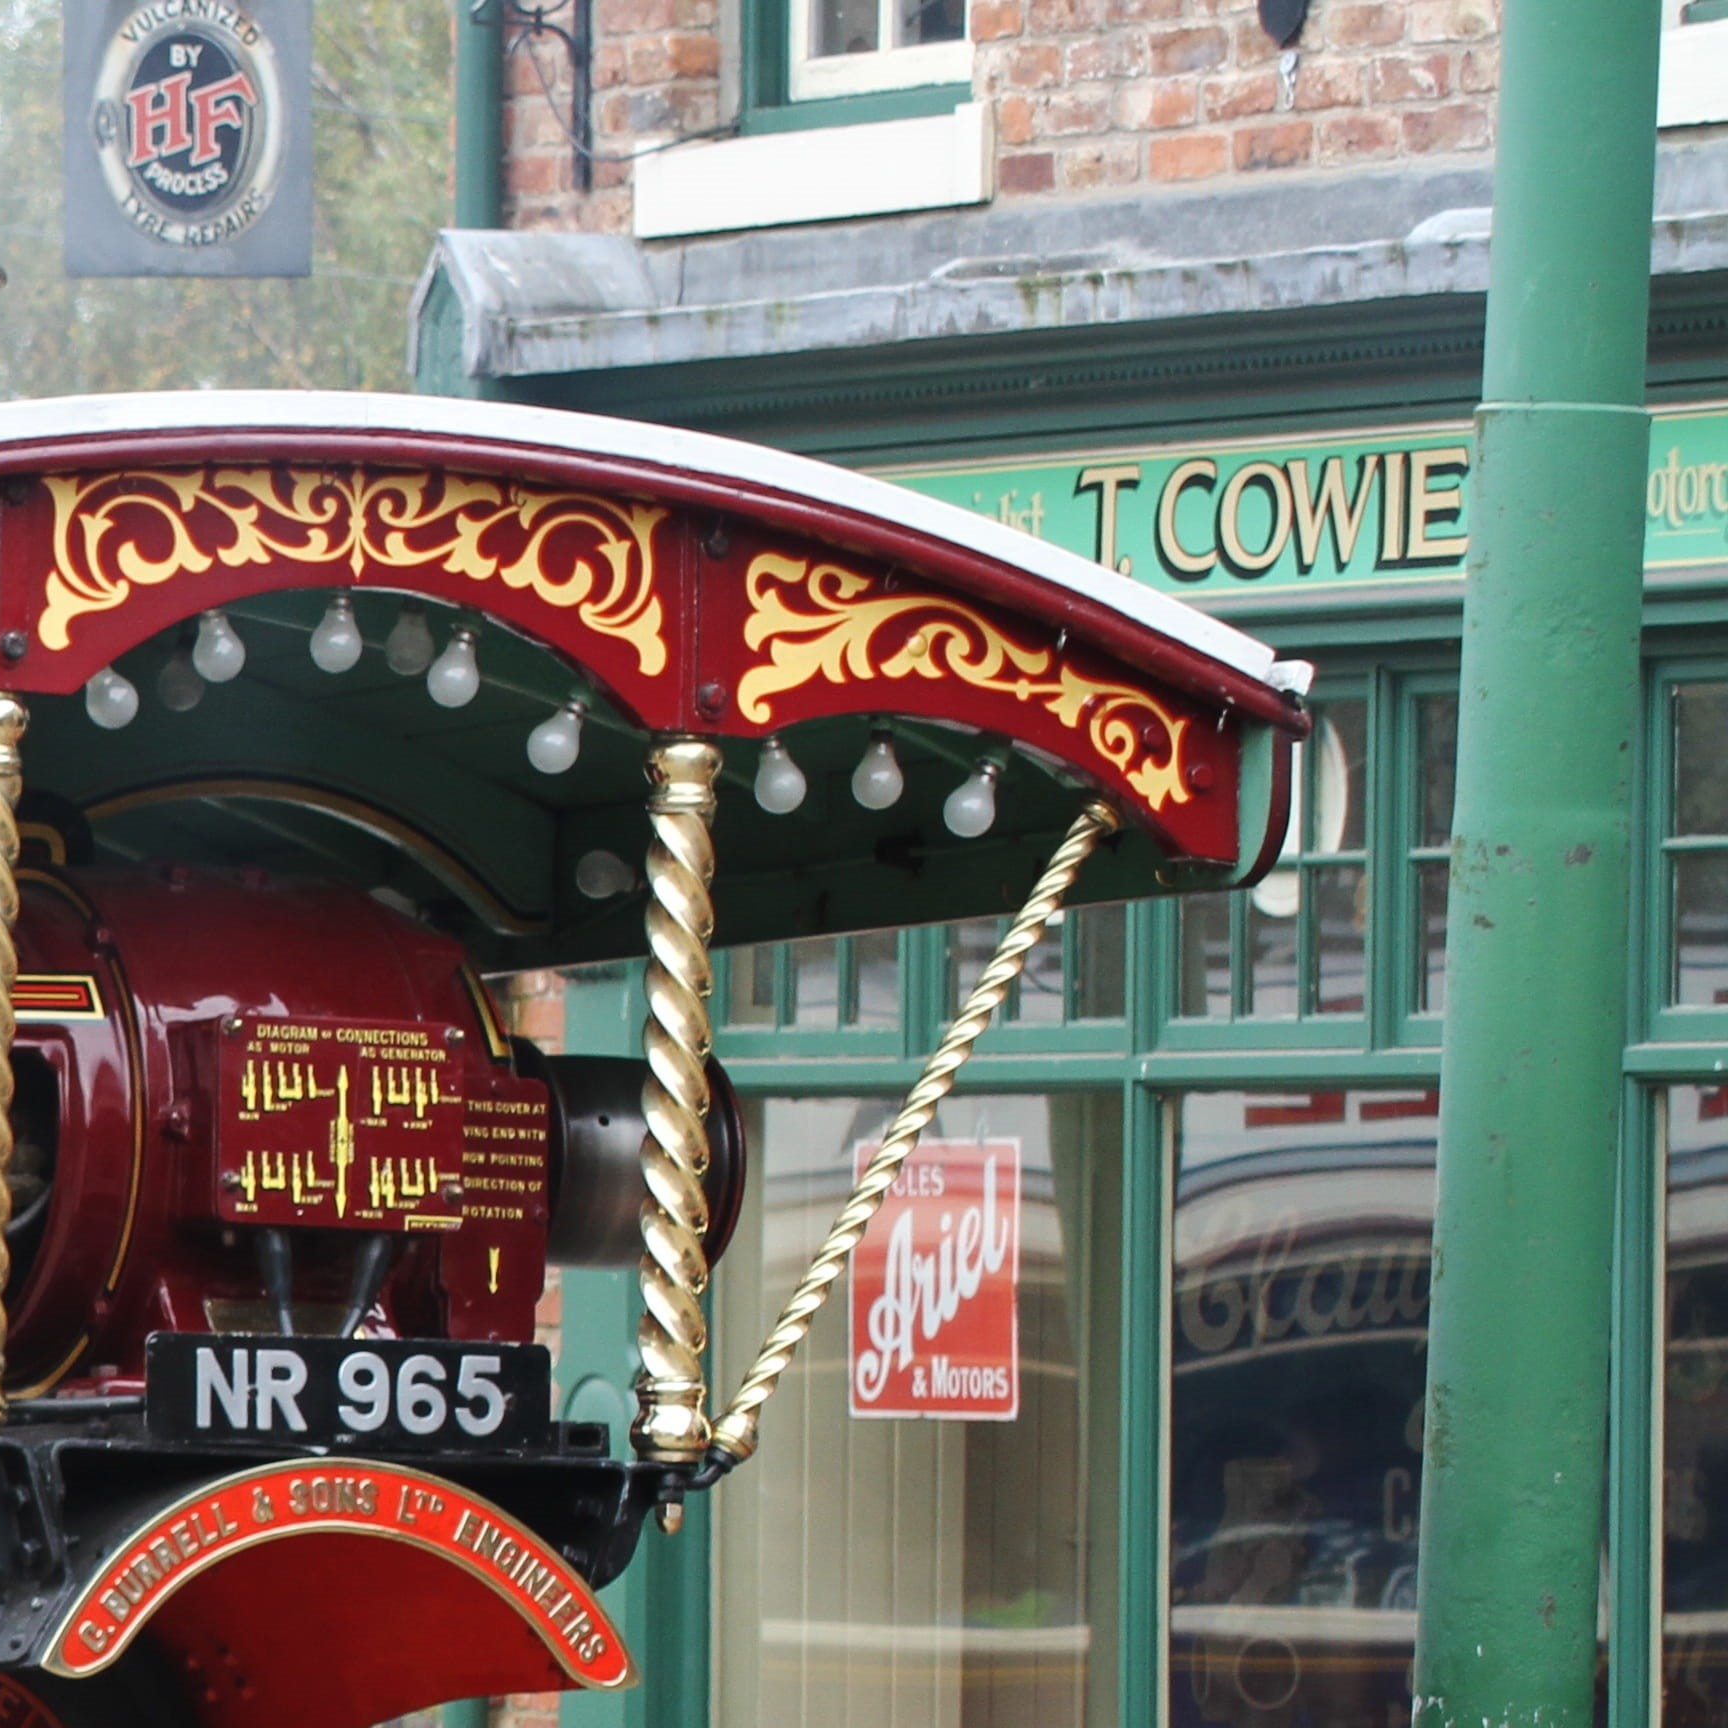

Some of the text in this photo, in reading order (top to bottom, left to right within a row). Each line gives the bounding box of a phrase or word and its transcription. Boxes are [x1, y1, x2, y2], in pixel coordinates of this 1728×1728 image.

[121, 0, 259, 47] VULCANIZED
[169, 43, 203, 67] BY
[125, 69, 258, 168] HF
[143, 160, 229, 196] PROCESS
[121, 186, 270, 248] TYRE REPAIRS
[1152, 445, 1471, 584] COWIE
[256, 1024, 318, 1041] DIAGRAM
[335, 1027, 429, 1047] CONNECTIONS
[269, 1042, 311, 1055] MOTOR
[380, 1048, 447, 1063] GENERATOR
[462, 1125, 489, 1139] VING
[490, 1151, 545, 1168] POINTING
[463, 1176, 525, 1193] DIRECTION
[885, 1162, 944, 1198] CLES
[461, 1204, 524, 1220] ROTATION
[856, 1154, 1009, 1402] Ariel
[195, 1347, 509, 1437] NR 965
[912, 1355, 1010, 1399] & MOTORS
[99, 1500, 239, 1623] BURRELL
[251, 1485, 275, 1524] &
[288, 1475, 380, 1516] SONS
[452, 1507, 608, 1664] ENGINEERS
